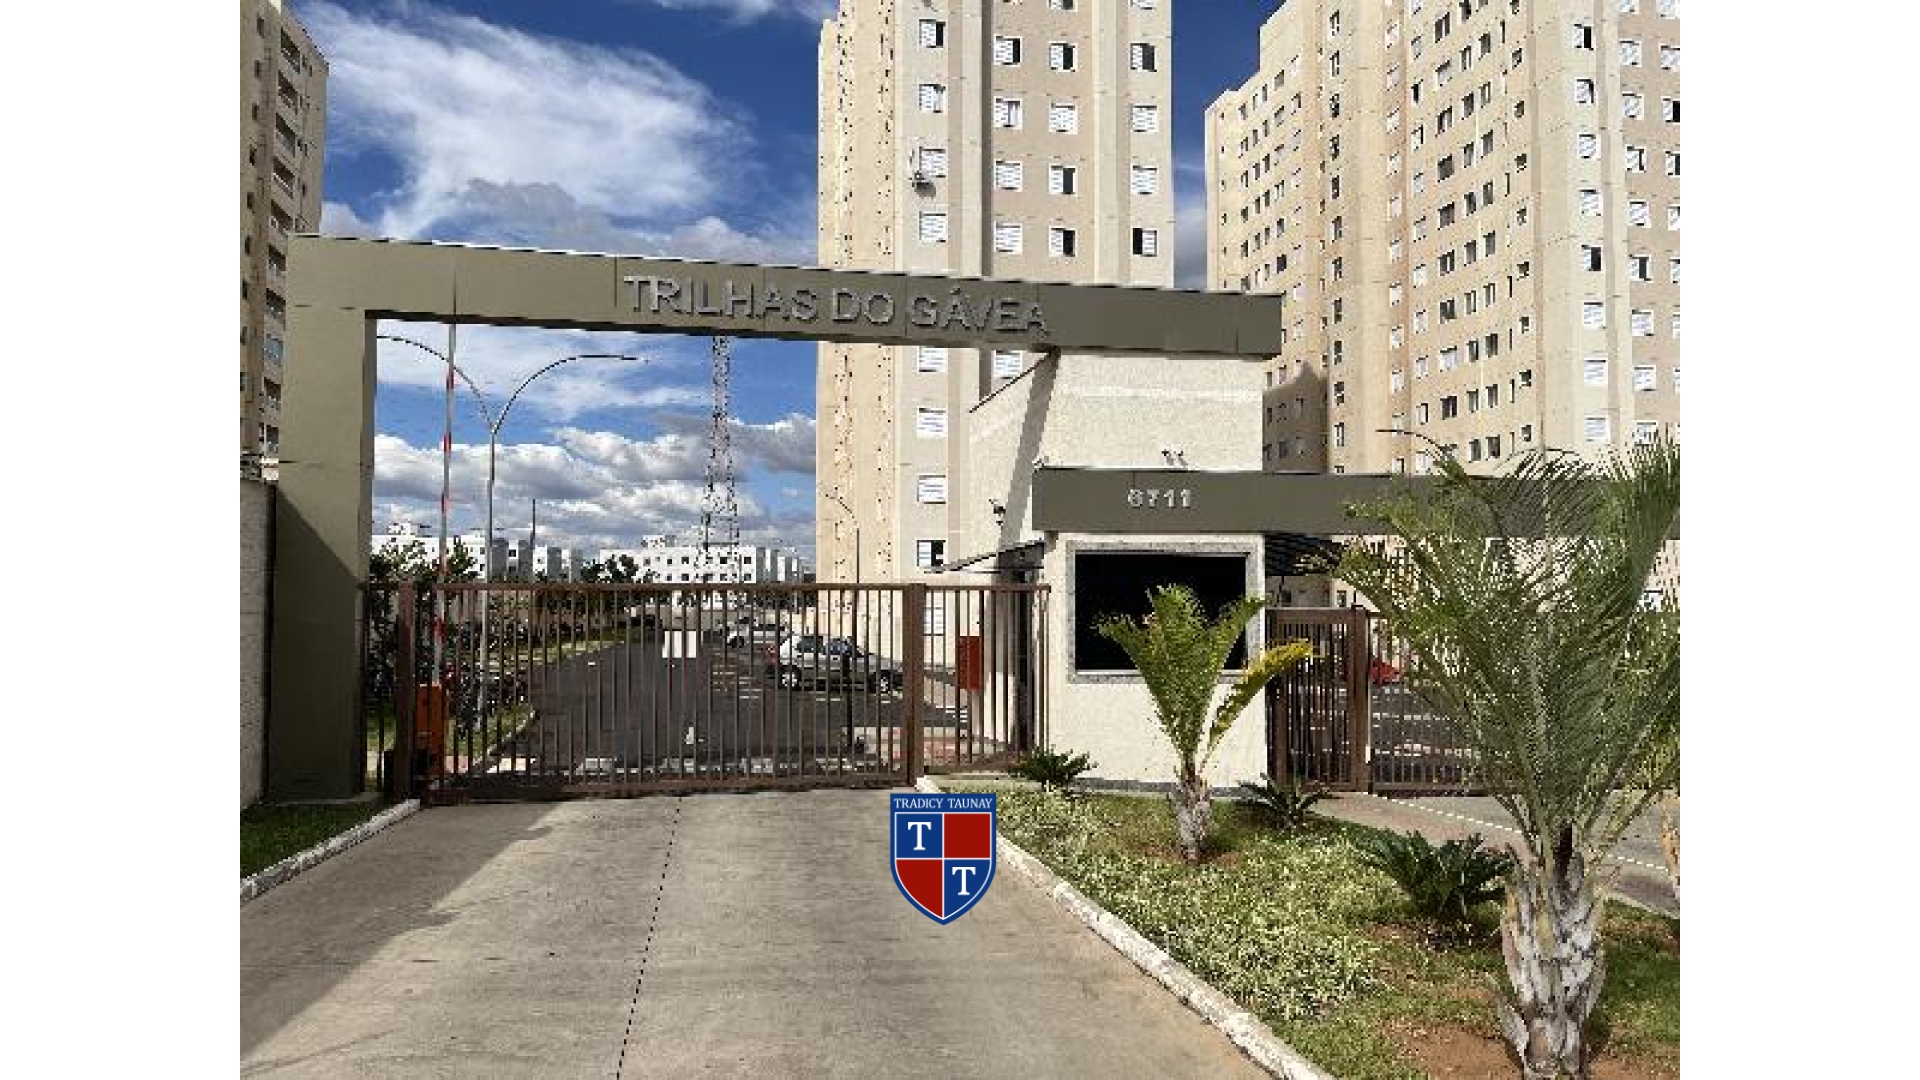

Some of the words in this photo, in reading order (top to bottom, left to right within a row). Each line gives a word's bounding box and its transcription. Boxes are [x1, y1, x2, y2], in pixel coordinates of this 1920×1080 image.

[623, 275, 819, 322] TRILHAS
[831, 287, 895, 325] DO
[910, 286, 1049, 335] GÁVEA
